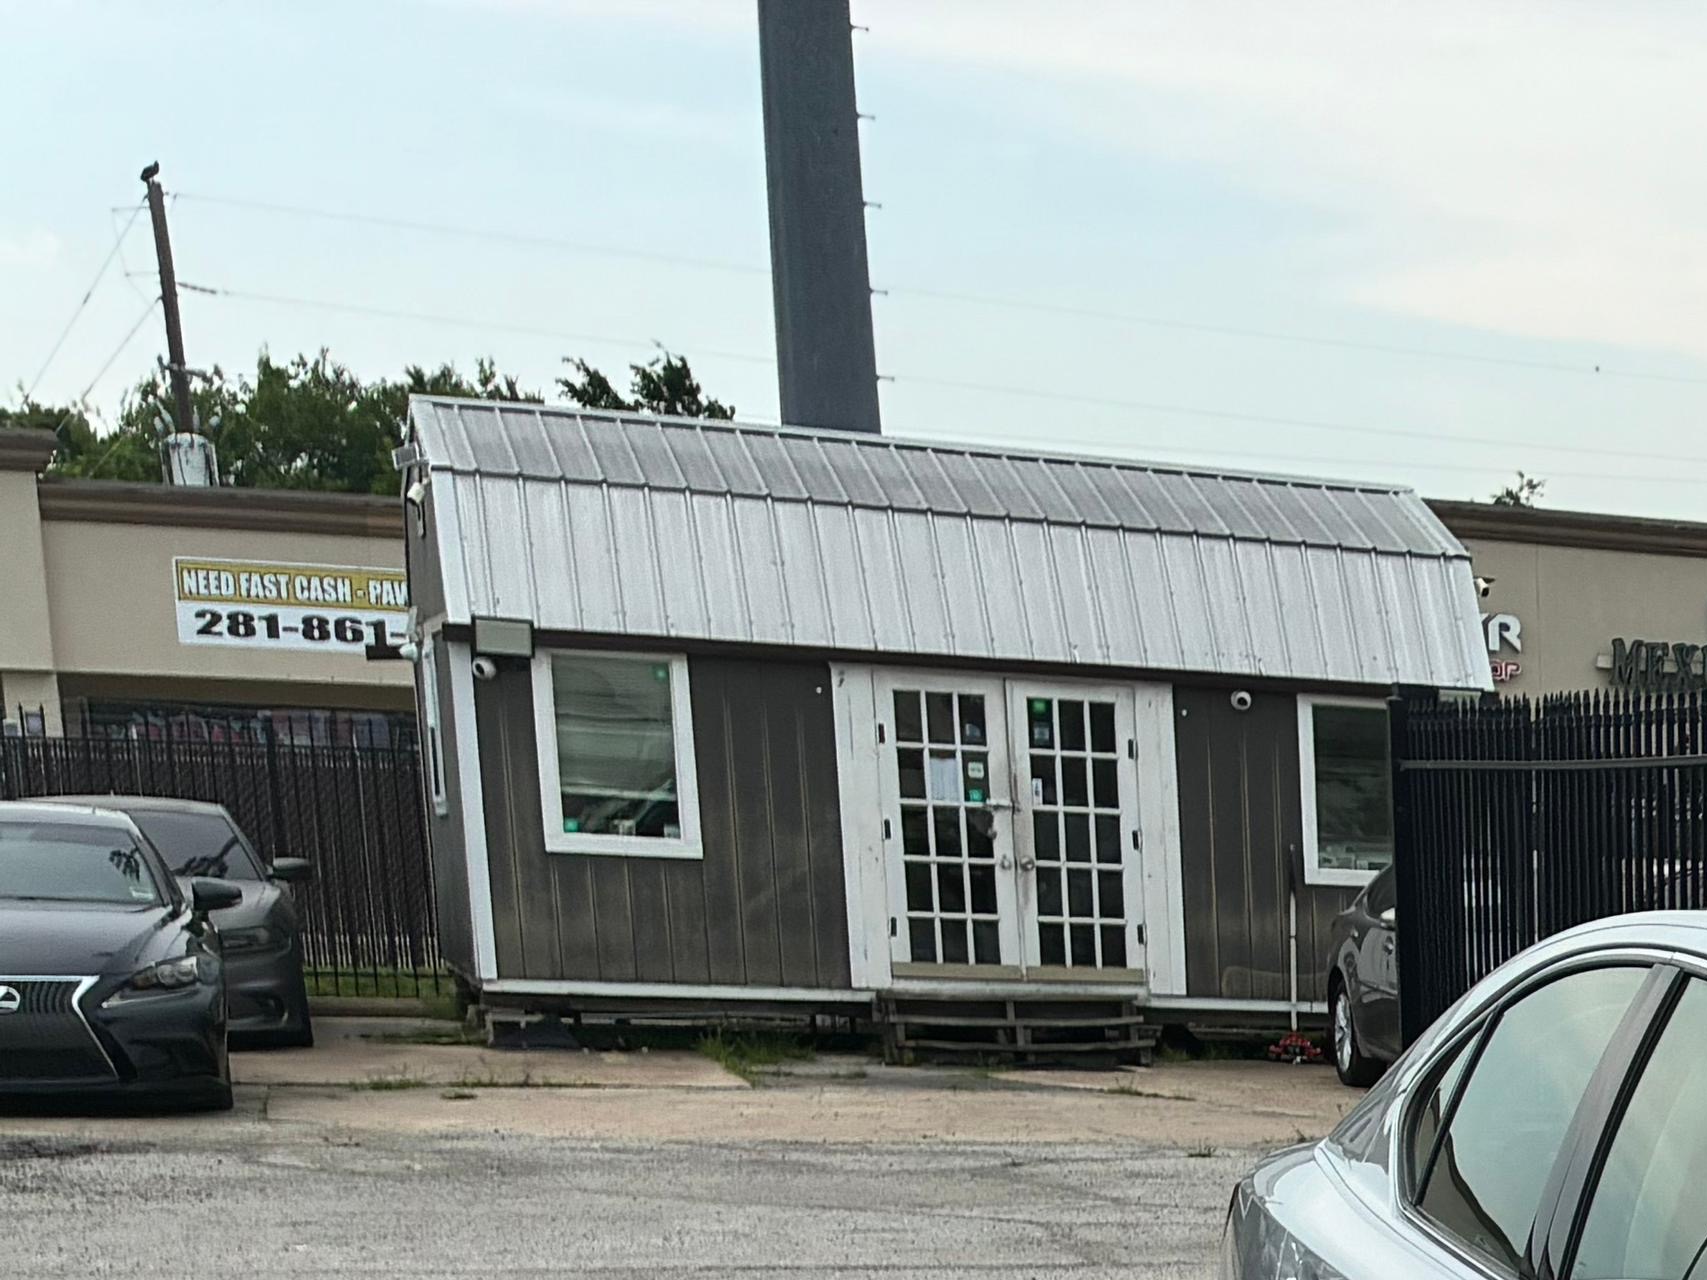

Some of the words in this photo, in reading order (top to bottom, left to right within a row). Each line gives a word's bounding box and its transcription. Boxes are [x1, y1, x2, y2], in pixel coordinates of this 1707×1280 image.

[182, 568, 236, 597] NEED
[239, 571, 290, 601] FAST
[294, 574, 353, 603] CASH
